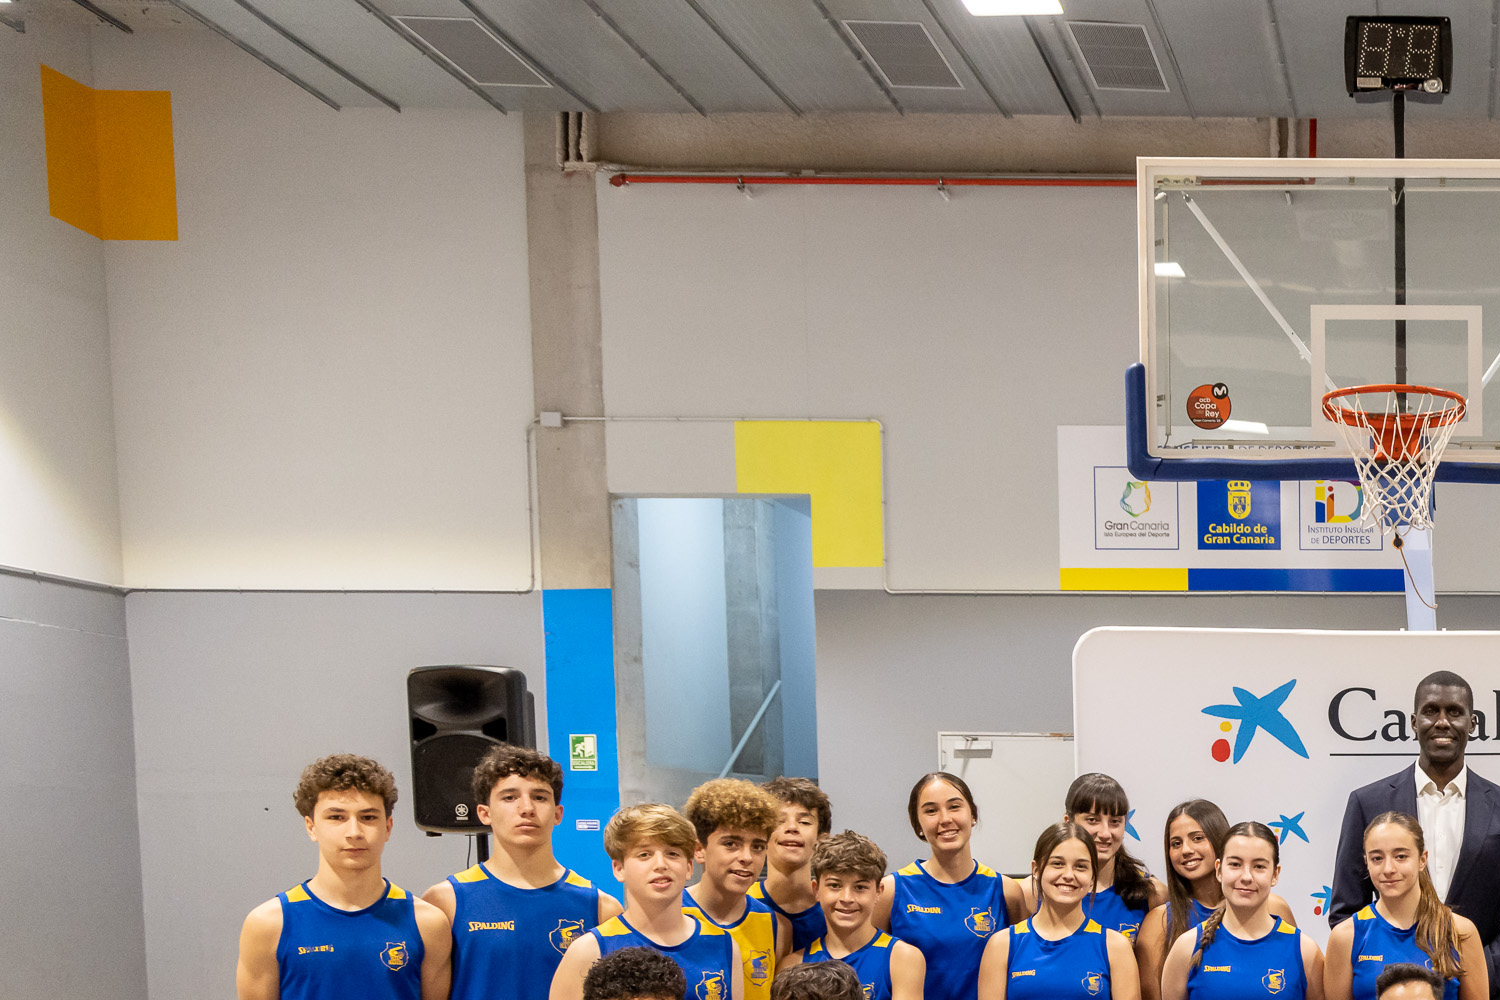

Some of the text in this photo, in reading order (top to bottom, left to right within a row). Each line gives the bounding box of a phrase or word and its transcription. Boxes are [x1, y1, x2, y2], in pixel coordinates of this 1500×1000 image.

[1194, 402, 1217, 411] Copa
[1205, 410, 1220, 418] Rey
[1209, 523, 1267, 534] Cabildo de
[1203, 534, 1275, 544] Gran Canaria
[1322, 536, 1371, 544] DEPORTES
[907, 904, 942, 914] SPALDIN
[469, 921, 515, 932] SPALDING
